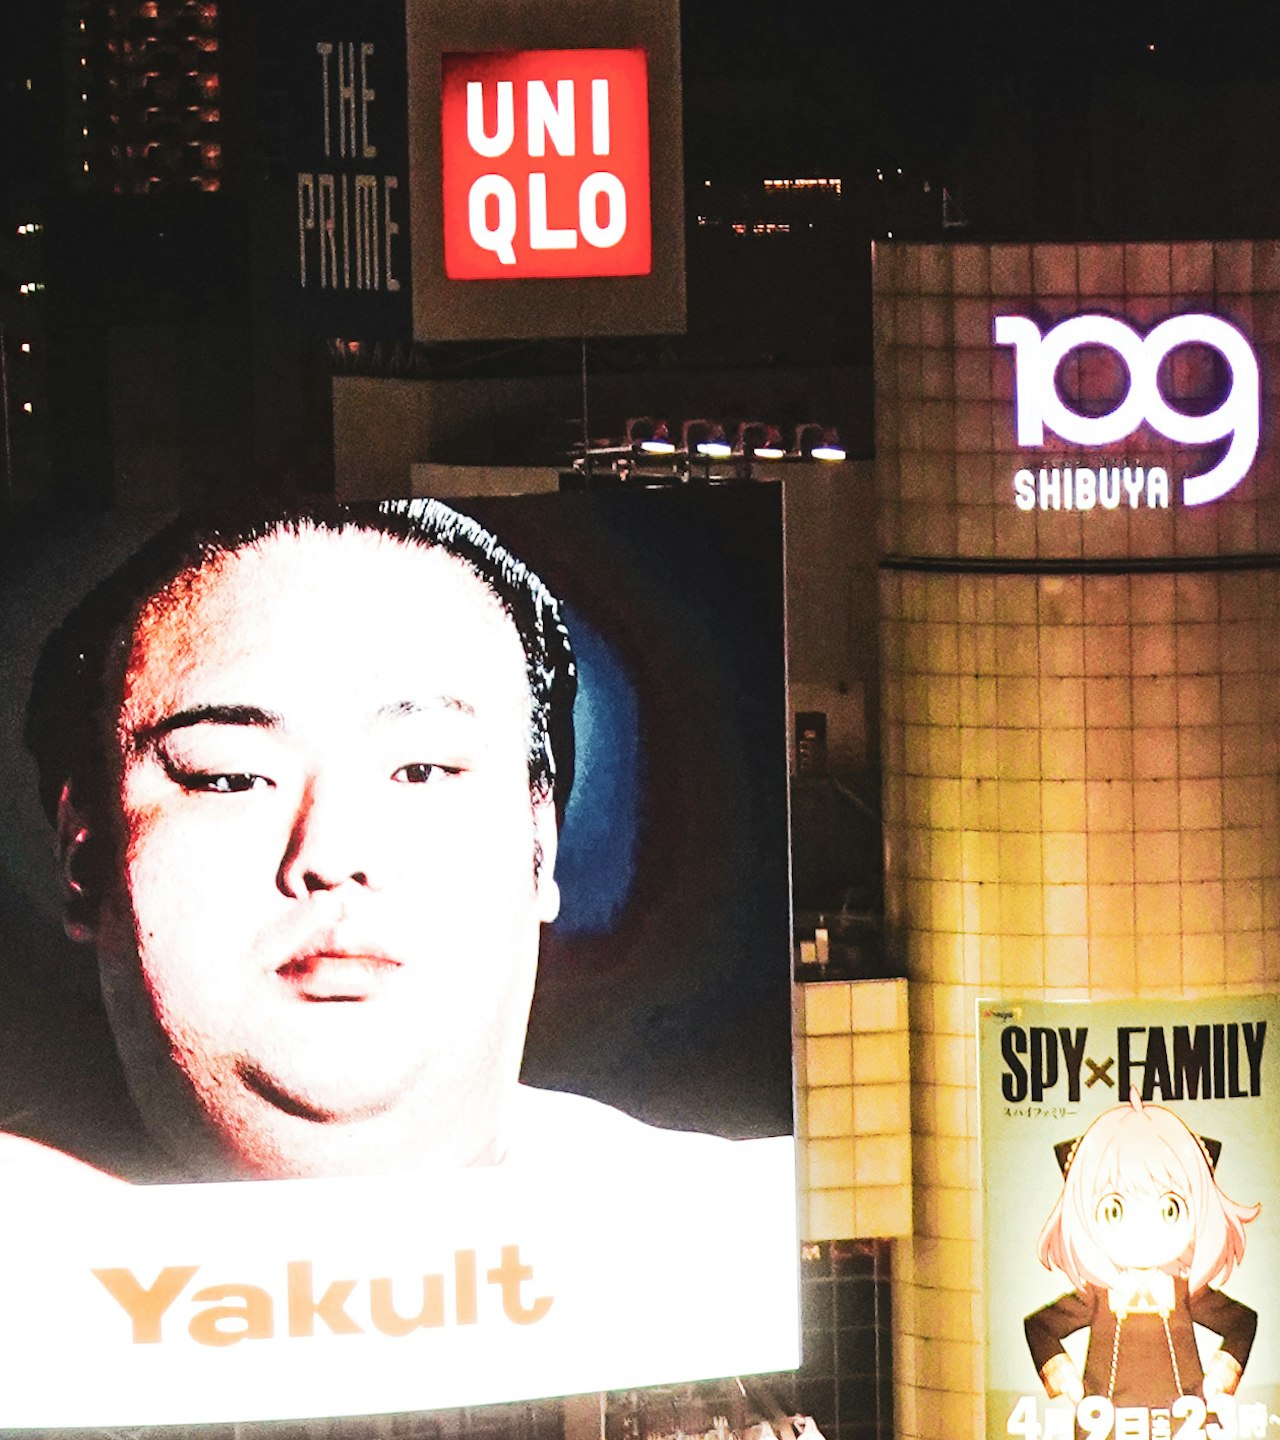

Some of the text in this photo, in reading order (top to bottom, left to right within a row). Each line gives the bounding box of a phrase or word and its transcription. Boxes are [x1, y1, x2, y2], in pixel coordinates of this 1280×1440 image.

[316, 42, 377, 158] THE
[466, 79, 610, 157] UNI
[298, 174, 400, 291] PRIME
[467, 172, 627, 265] QLO
[994, 314, 1260, 506] 109
[1014, 467, 1169, 511] SHIBUYA
[91, 1244, 557, 1347] Yakult
